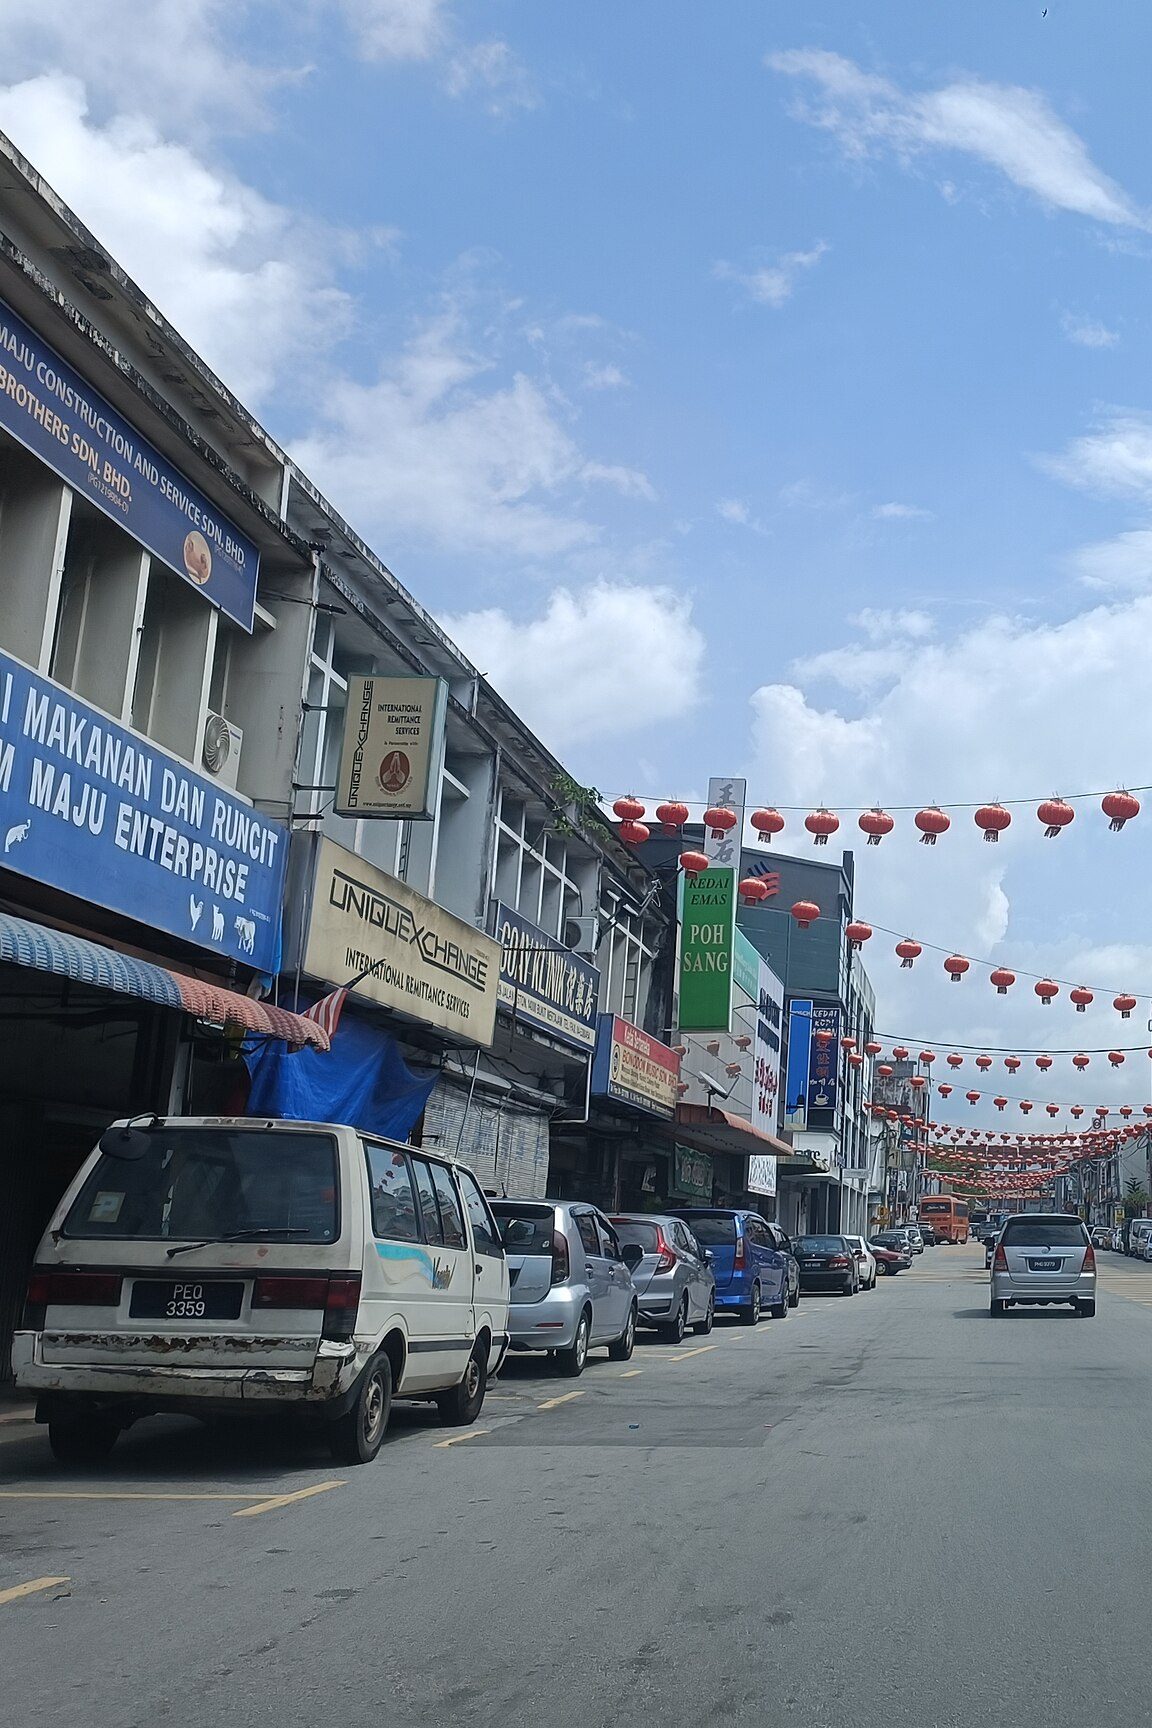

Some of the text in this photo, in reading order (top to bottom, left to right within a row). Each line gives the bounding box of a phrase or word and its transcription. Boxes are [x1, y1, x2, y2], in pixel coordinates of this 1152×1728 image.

[37, 361, 133, 463] CONSTRUCTION
[134, 452, 158, 486] AND
[160, 476, 201, 526] SERVICE
[201, 515, 224, 548] SDN.
[225, 536, 246, 568] BHD.
[71, 433, 101, 474] SDN.
[103, 461, 132, 502] BHD.
[378, 704, 423, 713] INTERNATIONAL
[387, 715, 421, 724] REMITTANCE
[395, 727, 420, 736] SERVICES
[348, 680, 374, 807] UNIQUEXCHANGE
[23, 686, 153, 801] MAKANAN
[160, 768, 206, 830] DAN
[211, 797, 279, 868] RUNCIT
[29, 758, 107, 835] MAJU
[114, 802, 249, 904] ENTERPRISE
[689, 878, 730, 889] KEDAI
[691, 894, 727, 906] EMAS
[330, 869, 488, 992] UNIQUEXCHANGE
[690, 924, 724, 945] POH
[683, 951, 729, 972] SANG
[345, 947, 471, 1019] INTERNATIONAL REMITTANCE SERVICES
[531, 940, 568, 1006] KLINIK
[813, 1010, 837, 1018] KEDAI
[173, 1284, 203, 1299] PEQ
[166, 1301, 205, 1317] 3359
